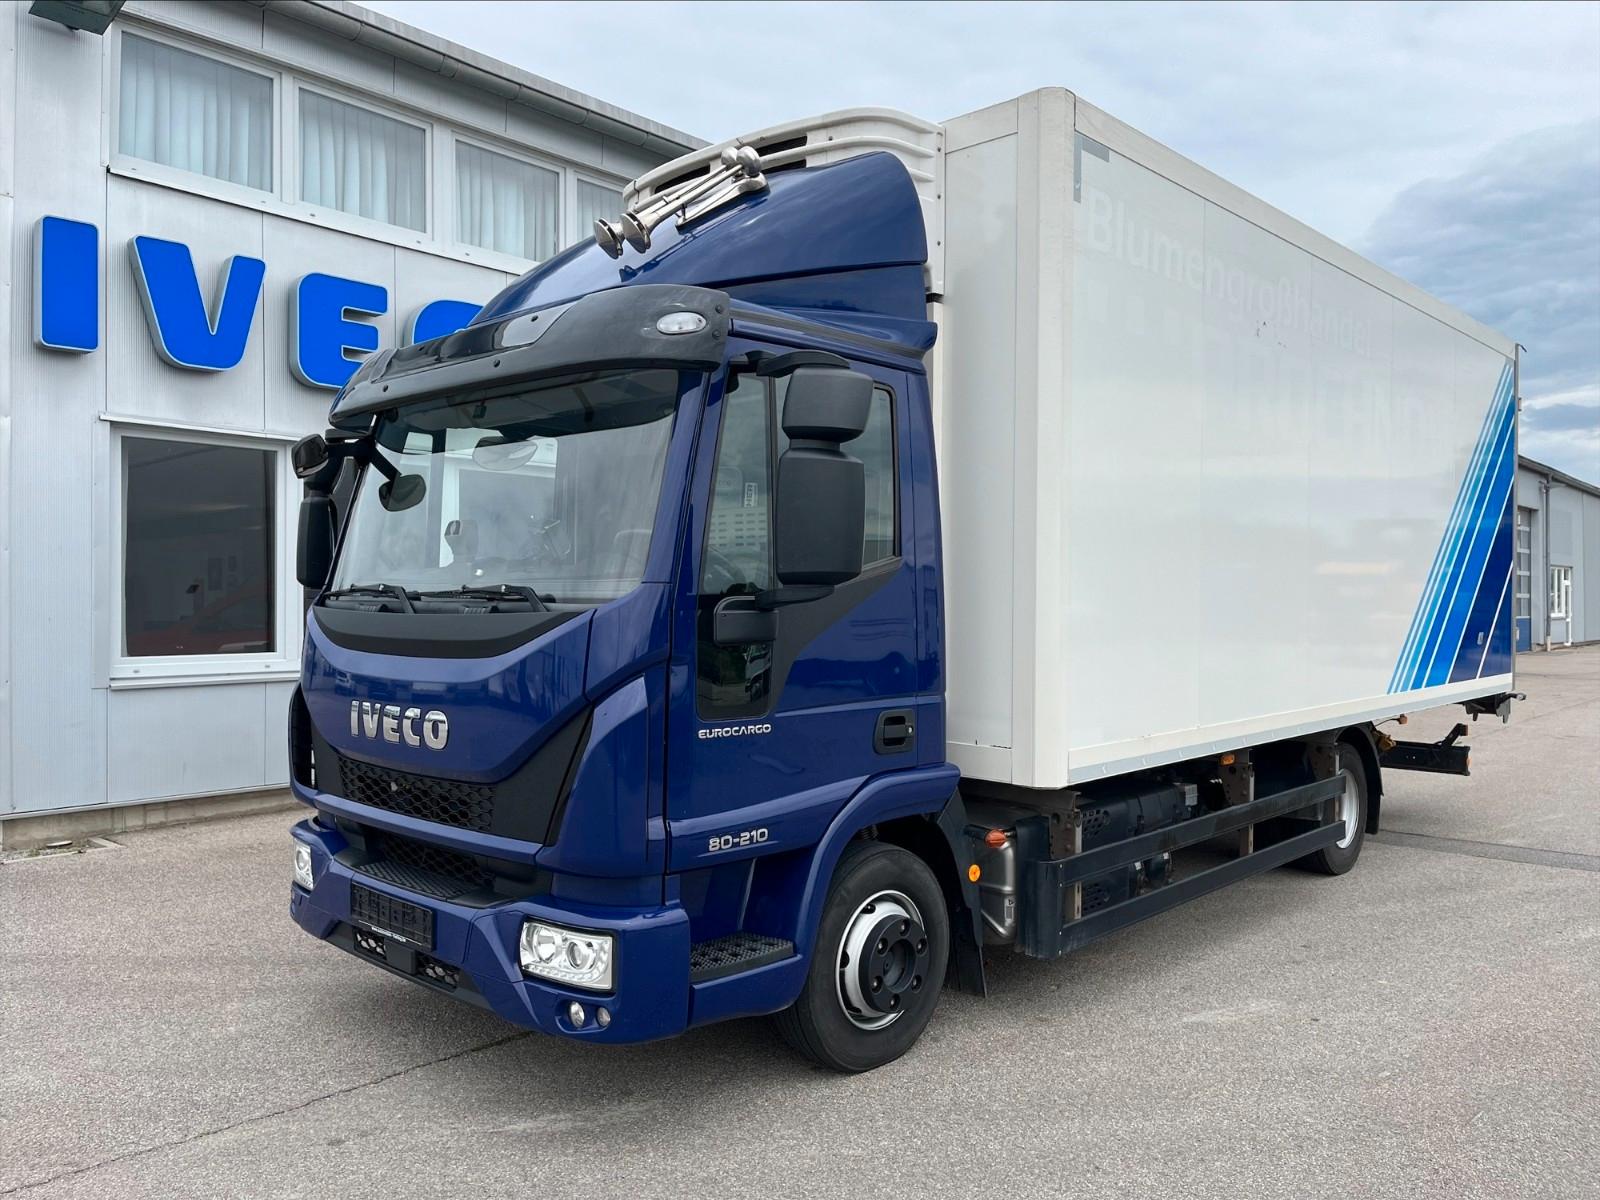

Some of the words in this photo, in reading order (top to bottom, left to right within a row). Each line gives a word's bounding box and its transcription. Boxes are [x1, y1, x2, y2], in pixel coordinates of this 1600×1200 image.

[1086, 185, 1372, 360] Blumengroßhandel
[350, 700, 449, 751] IVECO
[698, 724, 772, 739] EUROCARGO
[708, 828, 769, 852] 80-210
